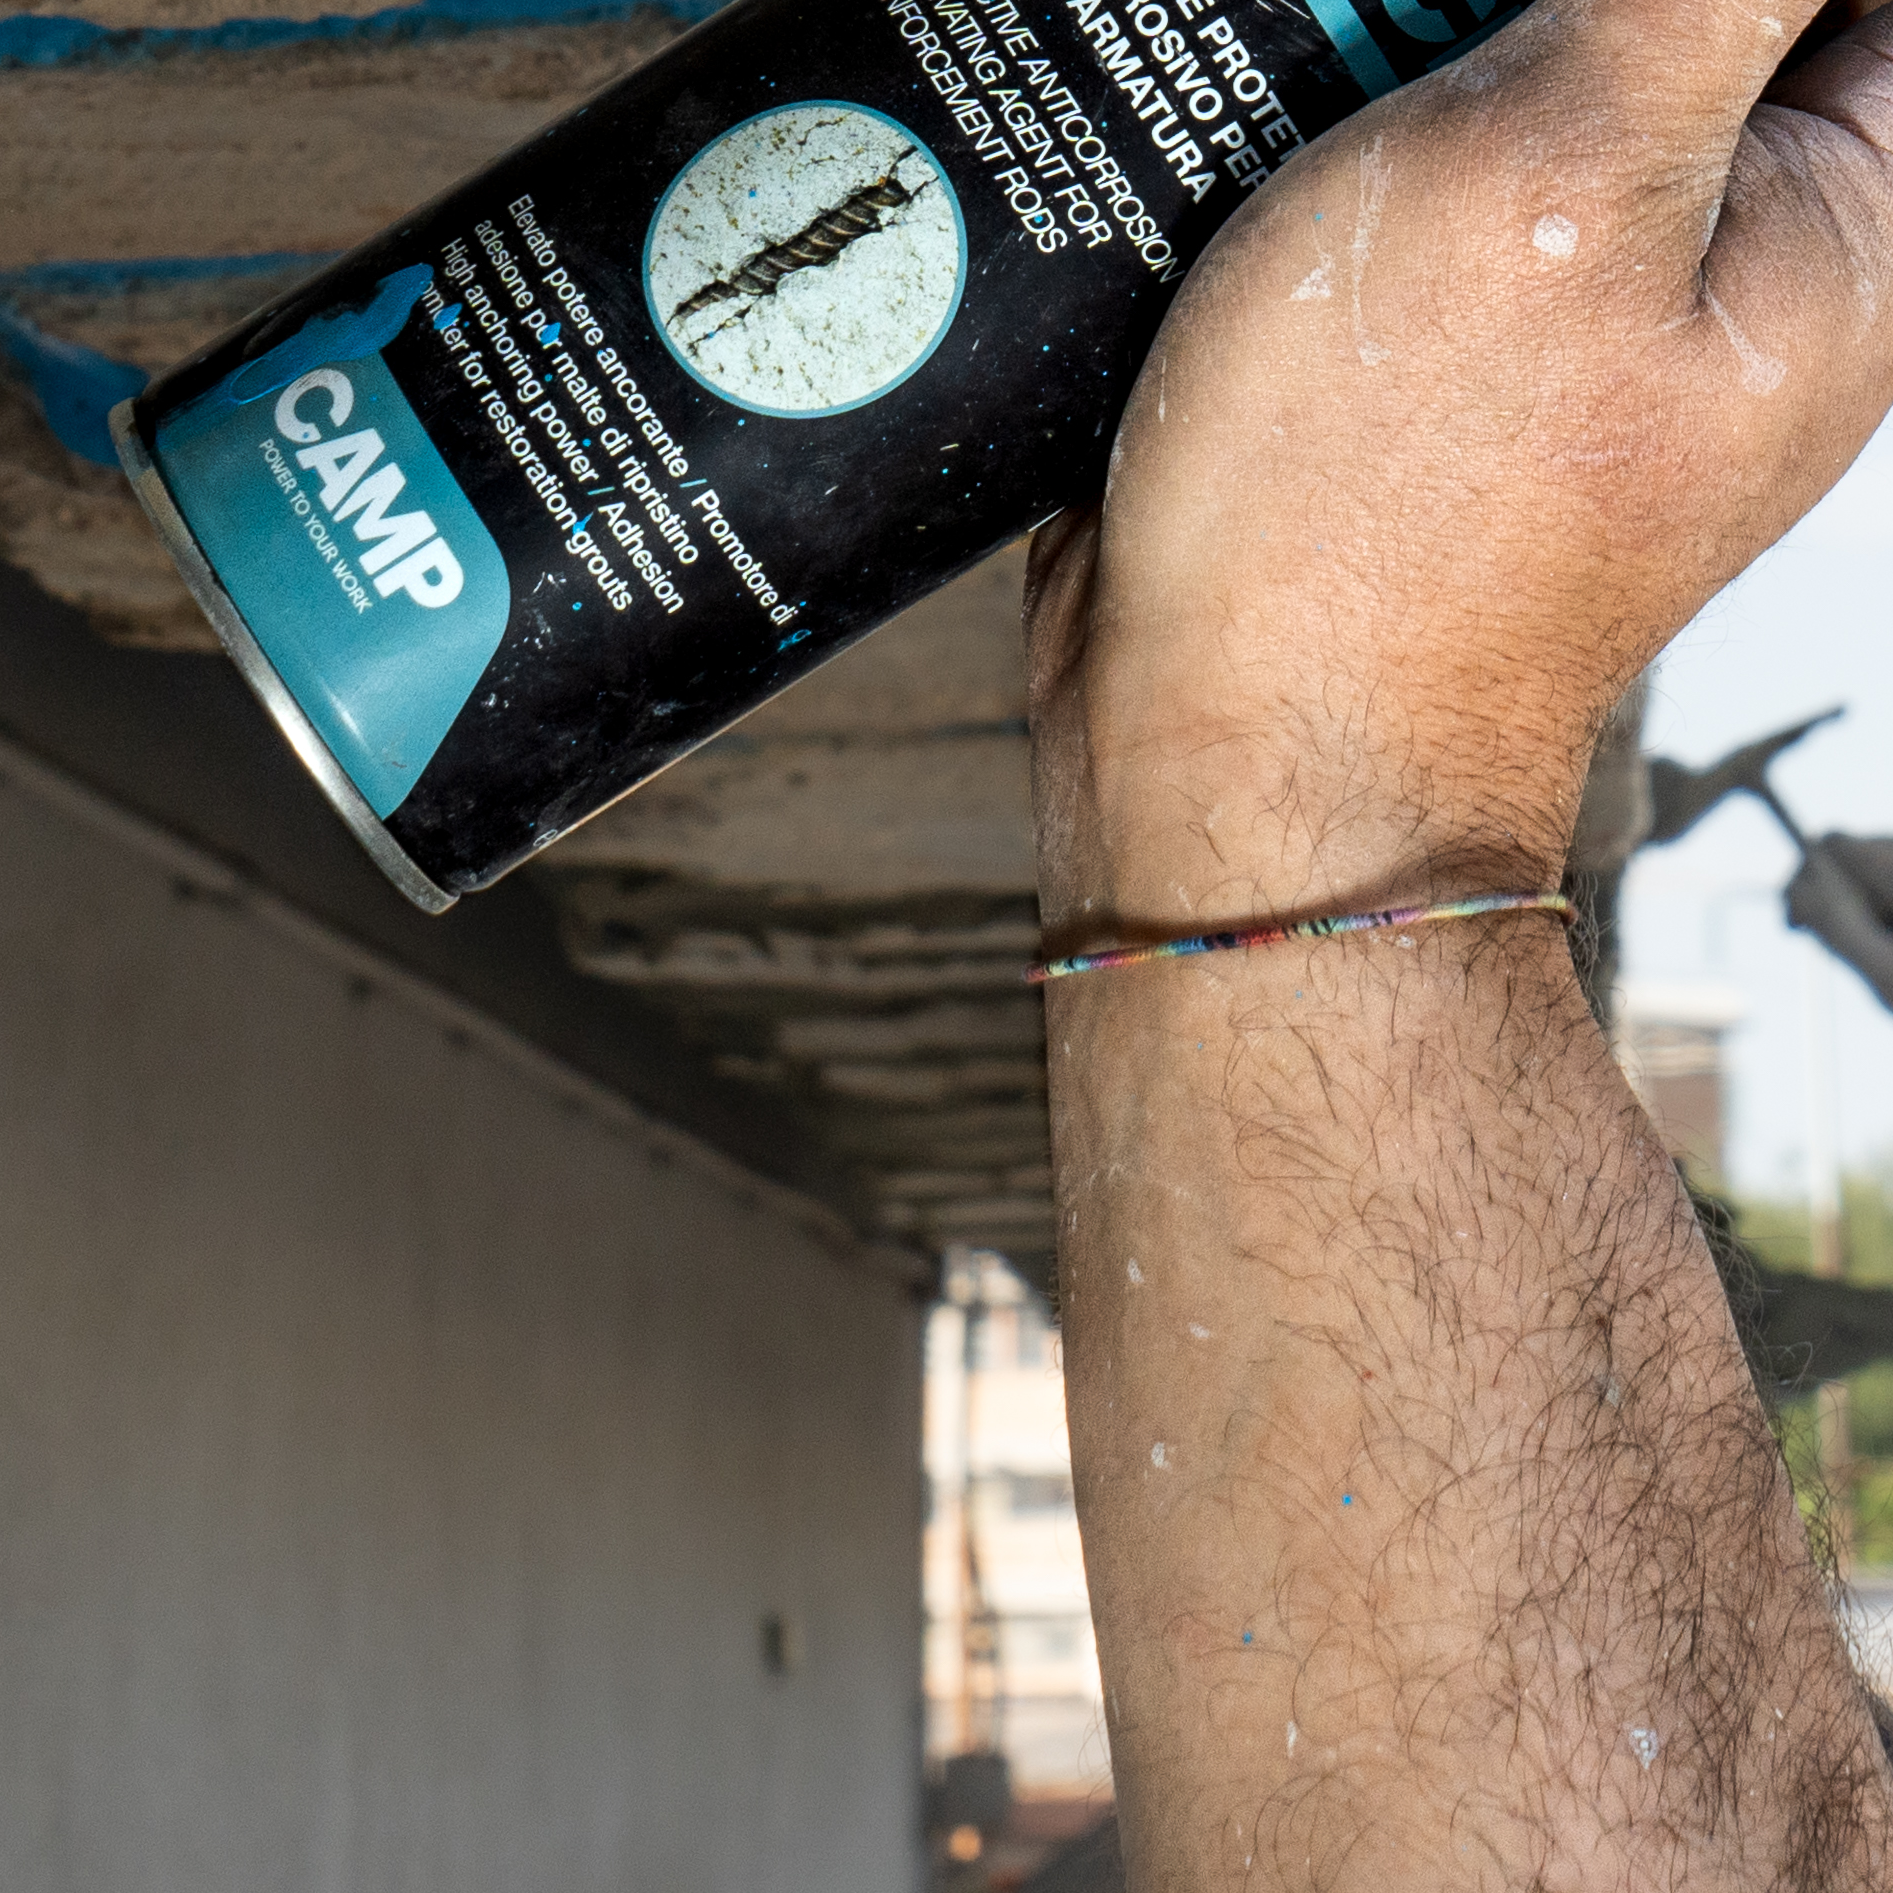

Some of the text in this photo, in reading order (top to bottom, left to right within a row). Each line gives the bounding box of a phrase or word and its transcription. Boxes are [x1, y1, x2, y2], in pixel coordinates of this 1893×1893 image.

[986, 88, 1077, 180] AGENT
[1052, 182, 1114, 247] FOR
[992, 165, 1070, 254] RODS
[1015, 58, 1185, 286] ANTICORROSION
[474, 219, 535, 310] adesione
[440, 237, 478, 287] High
[463, 283, 546, 404] anchoring
[527, 399, 601, 484] power
[596, 500, 686, 615] Adhesion
[507, 193, 558, 268] Elevato
[540, 265, 606, 348] potere
[595, 346, 690, 479] ancorante
[689, 487, 780, 607] Promotore
[768, 603, 800, 626] di
[550, 350, 608, 427] malte
[598, 426, 635, 457] di
[259, 438, 374, 616] POWER TO YOUR WORK
[274, 368, 466, 612] CAMP
[457, 350, 493, 389] for
[479, 388, 579, 532] restoration
[563, 529, 635, 610] grouts
[616, 454, 700, 564] ripristino
